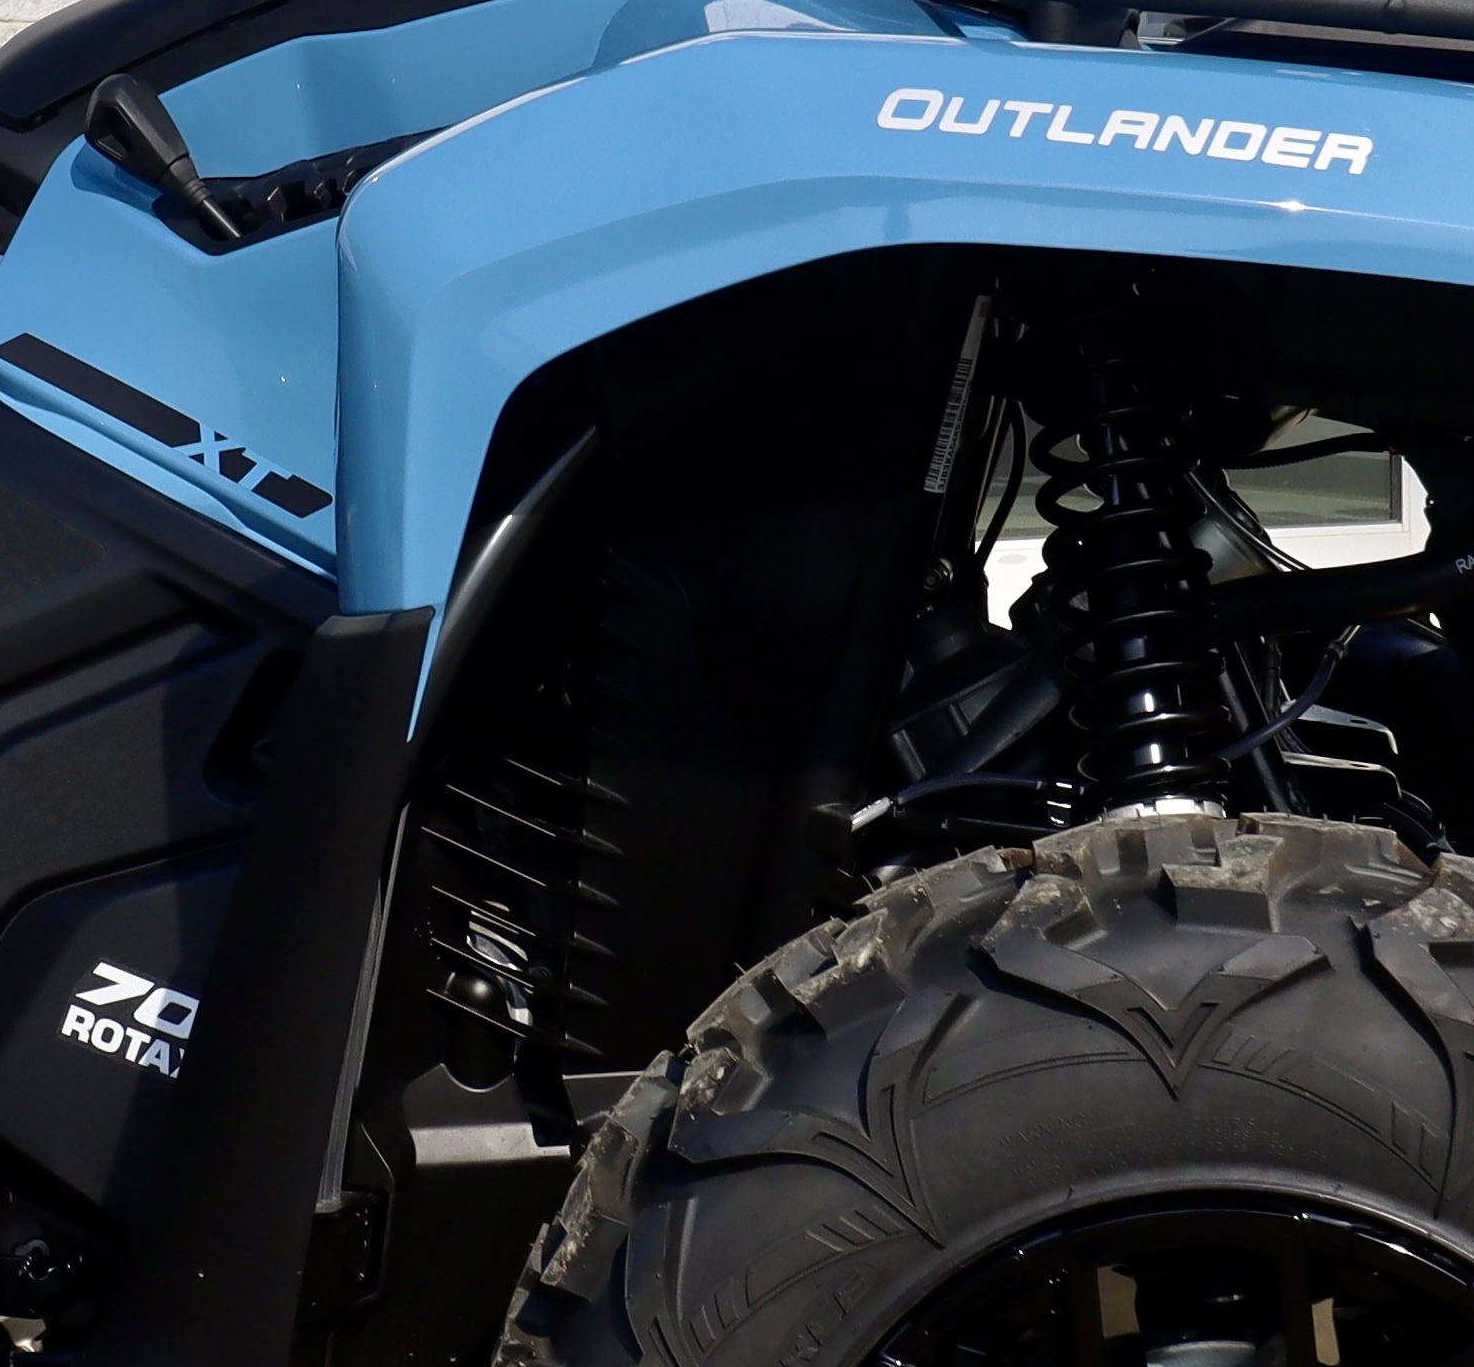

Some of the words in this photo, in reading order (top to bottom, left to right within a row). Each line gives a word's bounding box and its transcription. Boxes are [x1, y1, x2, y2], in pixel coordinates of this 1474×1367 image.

[877, 88, 1373, 175] OUTLANDER
[173, 424, 293, 491] XT
[75, 962, 200, 1039] 70
